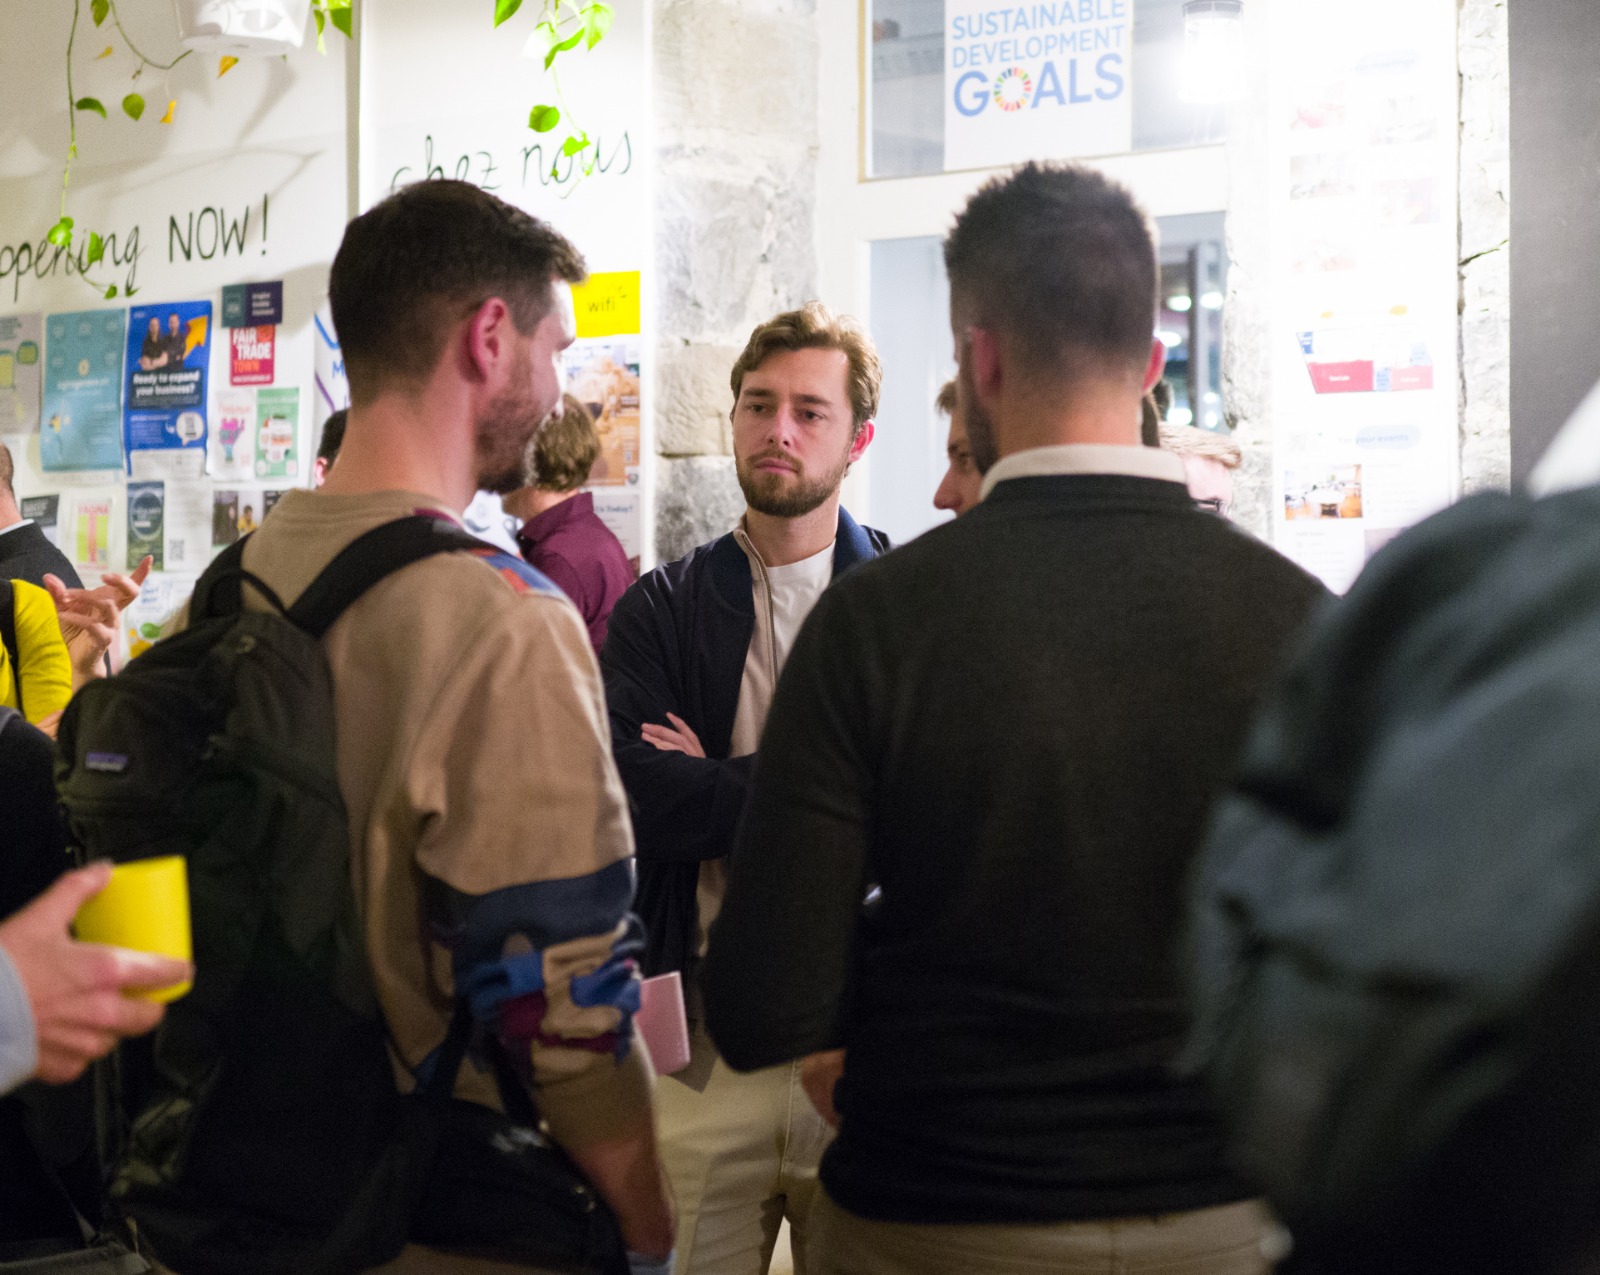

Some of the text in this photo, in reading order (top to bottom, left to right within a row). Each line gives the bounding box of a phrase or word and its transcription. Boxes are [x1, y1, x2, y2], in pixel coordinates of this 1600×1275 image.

[952, 0, 1125, 41] SUSTAINABLE
[952, 25, 1125, 69] DEVELOPMENT
[953, 52, 1125, 118] GOALS
[391, 131, 632, 193] chez nous
[169, 193, 268, 264] NOW!
[588, 296, 615, 312] wifi
[233, 328, 257, 345] FAIR
[238, 342, 272, 360] TRADE
[234, 360, 260, 374] TOWN
[133, 370, 200, 385] Ready to expand
[136, 382, 195, 398] your business?
